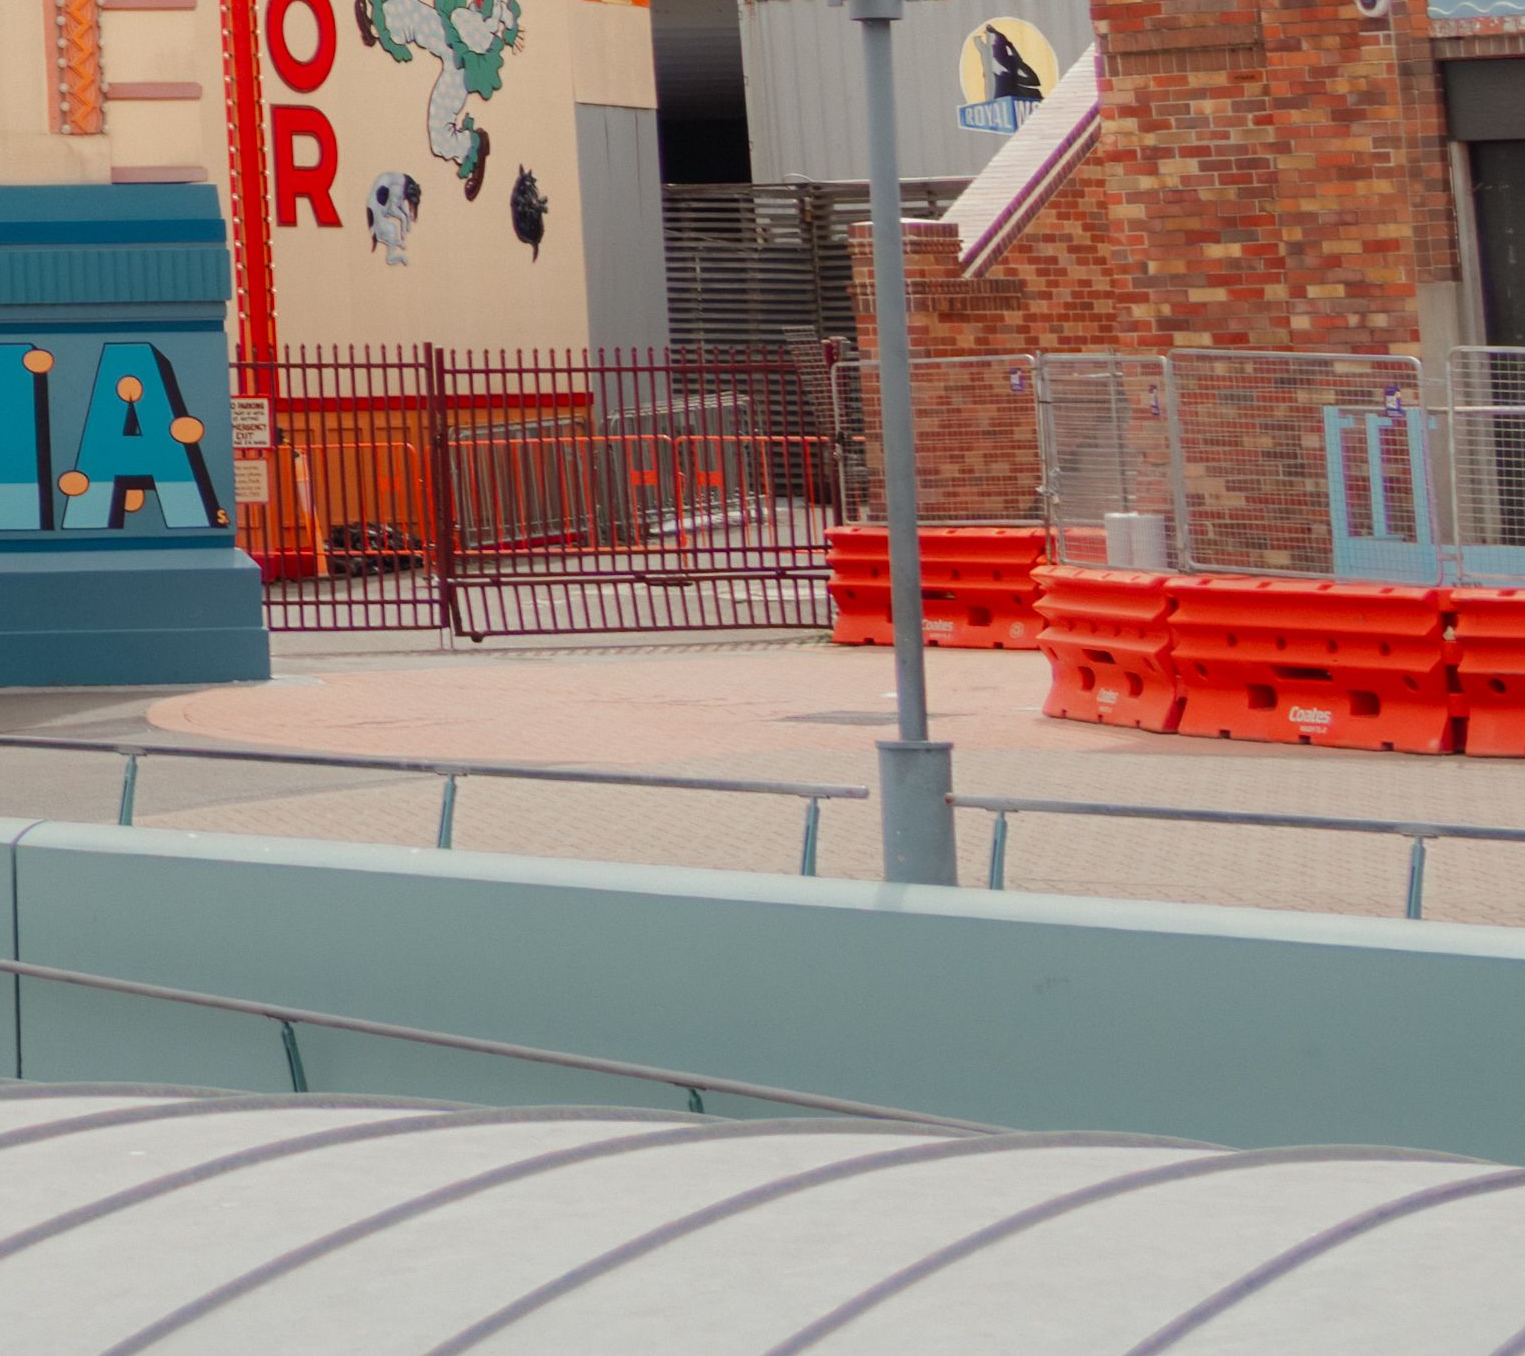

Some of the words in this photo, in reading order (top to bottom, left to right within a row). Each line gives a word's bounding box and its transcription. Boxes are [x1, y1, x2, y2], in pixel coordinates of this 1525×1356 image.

[965, 100, 1011, 129] ROYAL
[238, 402, 264, 410] PARKING
[1289, 705, 1331, 724] Coates
